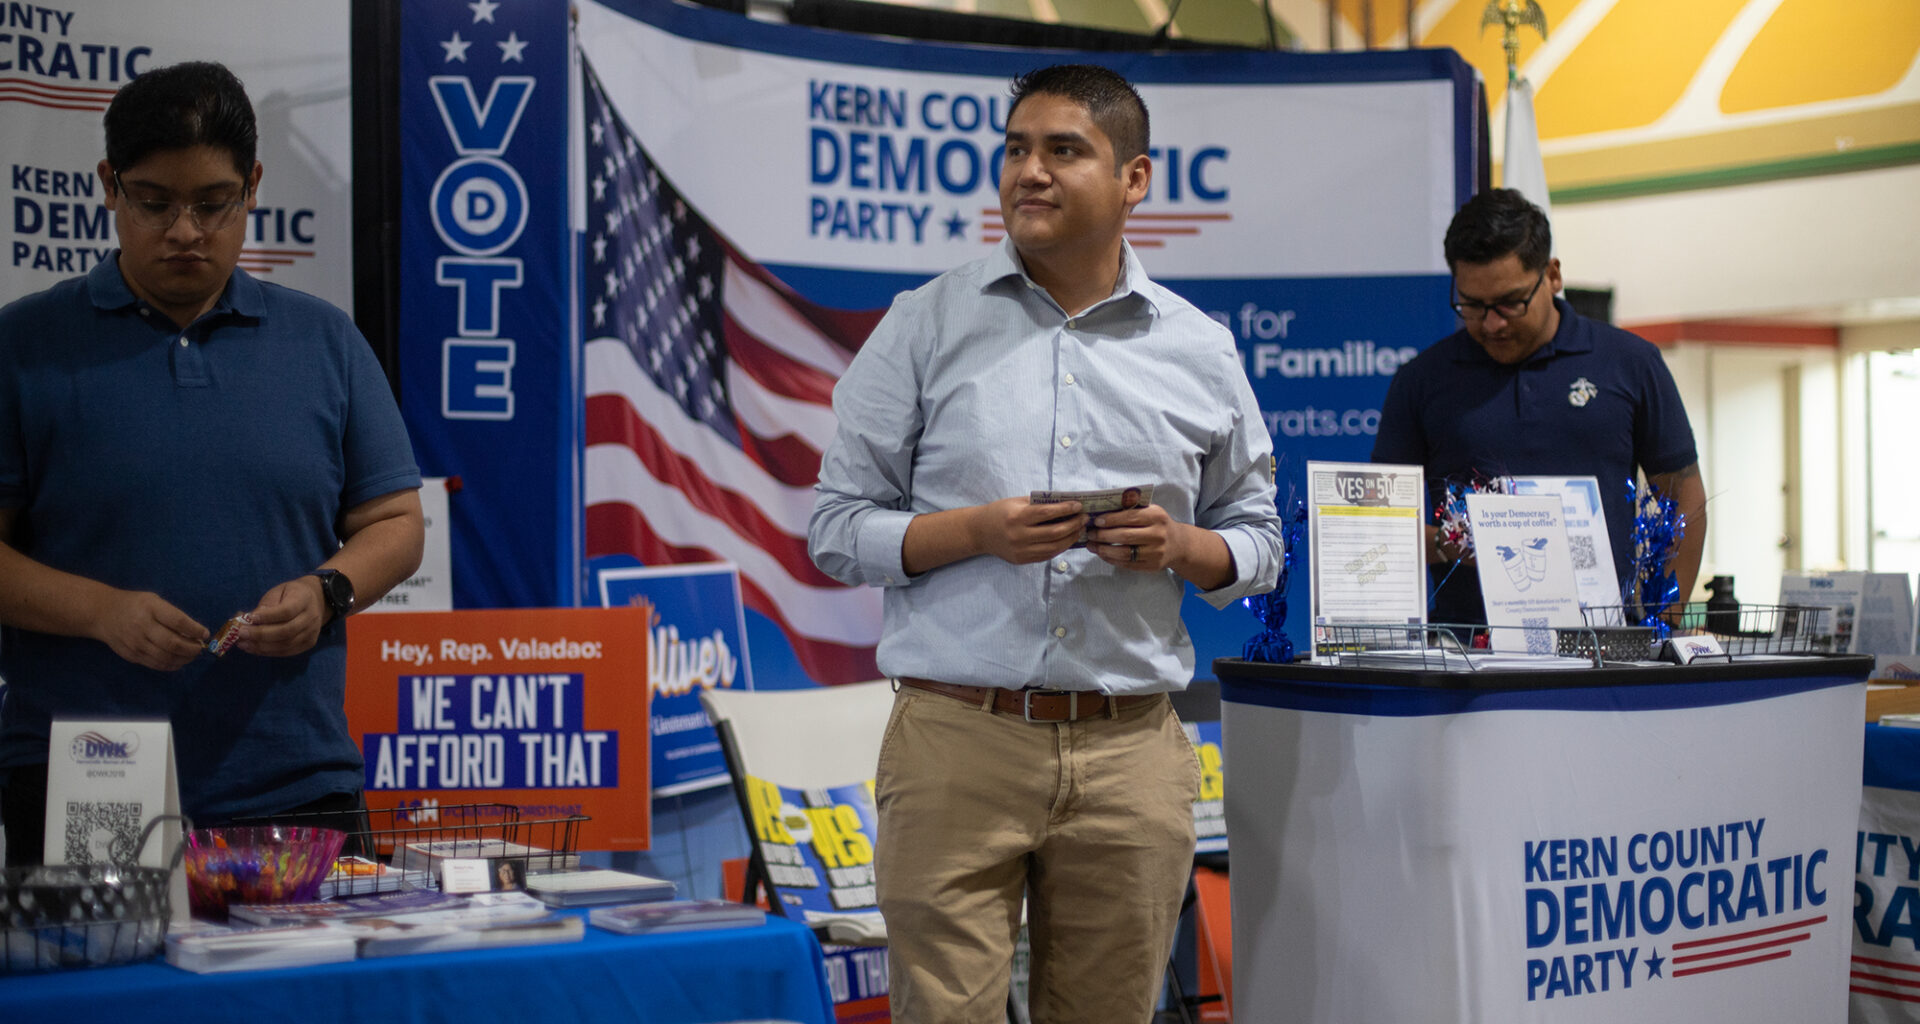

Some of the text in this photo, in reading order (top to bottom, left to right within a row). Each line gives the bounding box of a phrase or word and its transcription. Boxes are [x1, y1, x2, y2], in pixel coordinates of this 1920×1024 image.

[0, 2, 74, 36] NTY
[809, 79, 909, 129] KERN
[12, 164, 94, 197] KERN
[810, 196, 932, 244] PARTY
[428, 76, 536, 420] VOTE
[1238, 303, 1296, 339] for
[1254, 340, 1418, 378] Families
[1337, 477, 1364, 499] YES
[1366, 480, 1375, 489] ON
[1377, 478, 1396, 499] 50
[1478, 520, 1501, 528] worth
[1508, 521, 1521, 529] cup
[1523, 519, 1530, 527] of
[1481, 509, 1550, 520] Is your Democracy
[381, 637, 602, 666] Hey, Rep. Valadao:
[647, 624, 737, 698] liver
[412, 675, 571, 730] WE CAN'T
[86, 742, 129, 758] DWK
[374, 733, 608, 788] AFFORD THAT
[1525, 818, 1765, 882] KERN COUNTY
[1526, 848, 1828, 949] DEMOCRATIC
[1527, 947, 1639, 1001] PARTY
